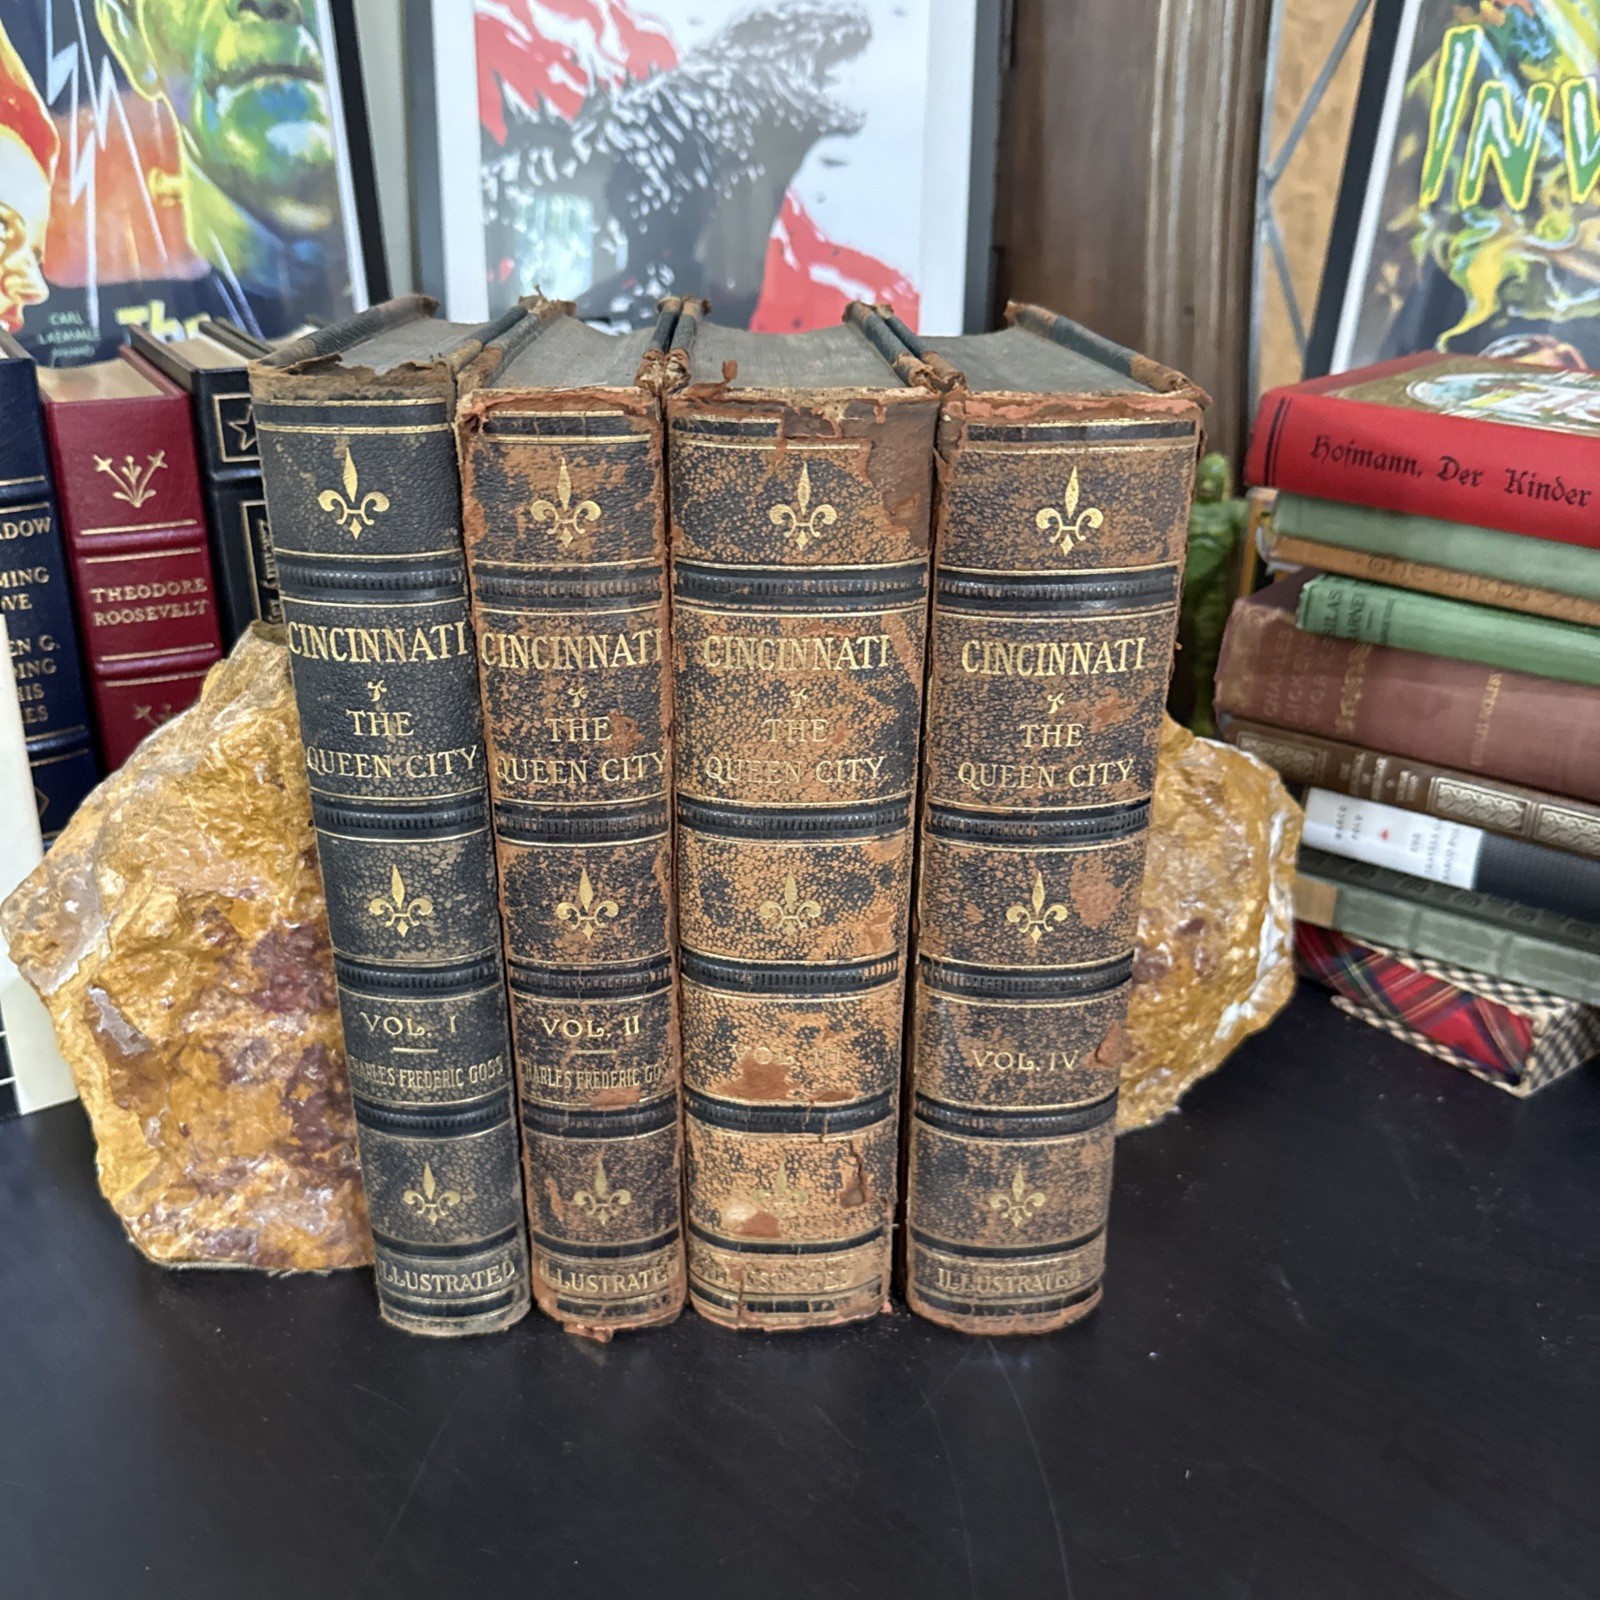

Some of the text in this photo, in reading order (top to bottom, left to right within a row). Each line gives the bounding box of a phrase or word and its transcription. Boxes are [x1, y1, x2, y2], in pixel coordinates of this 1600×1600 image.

[1436, 455, 1484, 488] Der
[1503, 467, 1593, 508] Kinder
[0, 516, 51, 540] DOW
[90, 577, 208, 604] THEODORE
[94, 599, 210, 627] ROOSEVELT
[288, 621, 468, 663] CINCINNATI
[481, 628, 663, 670] CINCINNATI
[703, 635, 890, 671] CINCINNATI
[961, 637, 1146, 676] CINCINNATI
[346, 709, 414, 737] THE
[545, 716, 613, 743] THE
[763, 718, 829, 743] THE
[1019, 723, 1085, 748] THE
[307, 745, 478, 779] QUEEN CITY
[495, 750, 668, 784] QUEEN CITY
[705, 756, 885, 784] QUEEN CITY
[958, 758, 1134, 790] QUEEN CITY
[360, 1012, 457, 1037] VOL. I
[623, 1015, 640, 1036] II
[400, 1067, 465, 1089] FREDERIC
[469, 1055, 504, 1083] GOSS
[972, 1049, 1080, 1072] VOL. IV
[576, 1068, 640, 1089] FREDERIC
